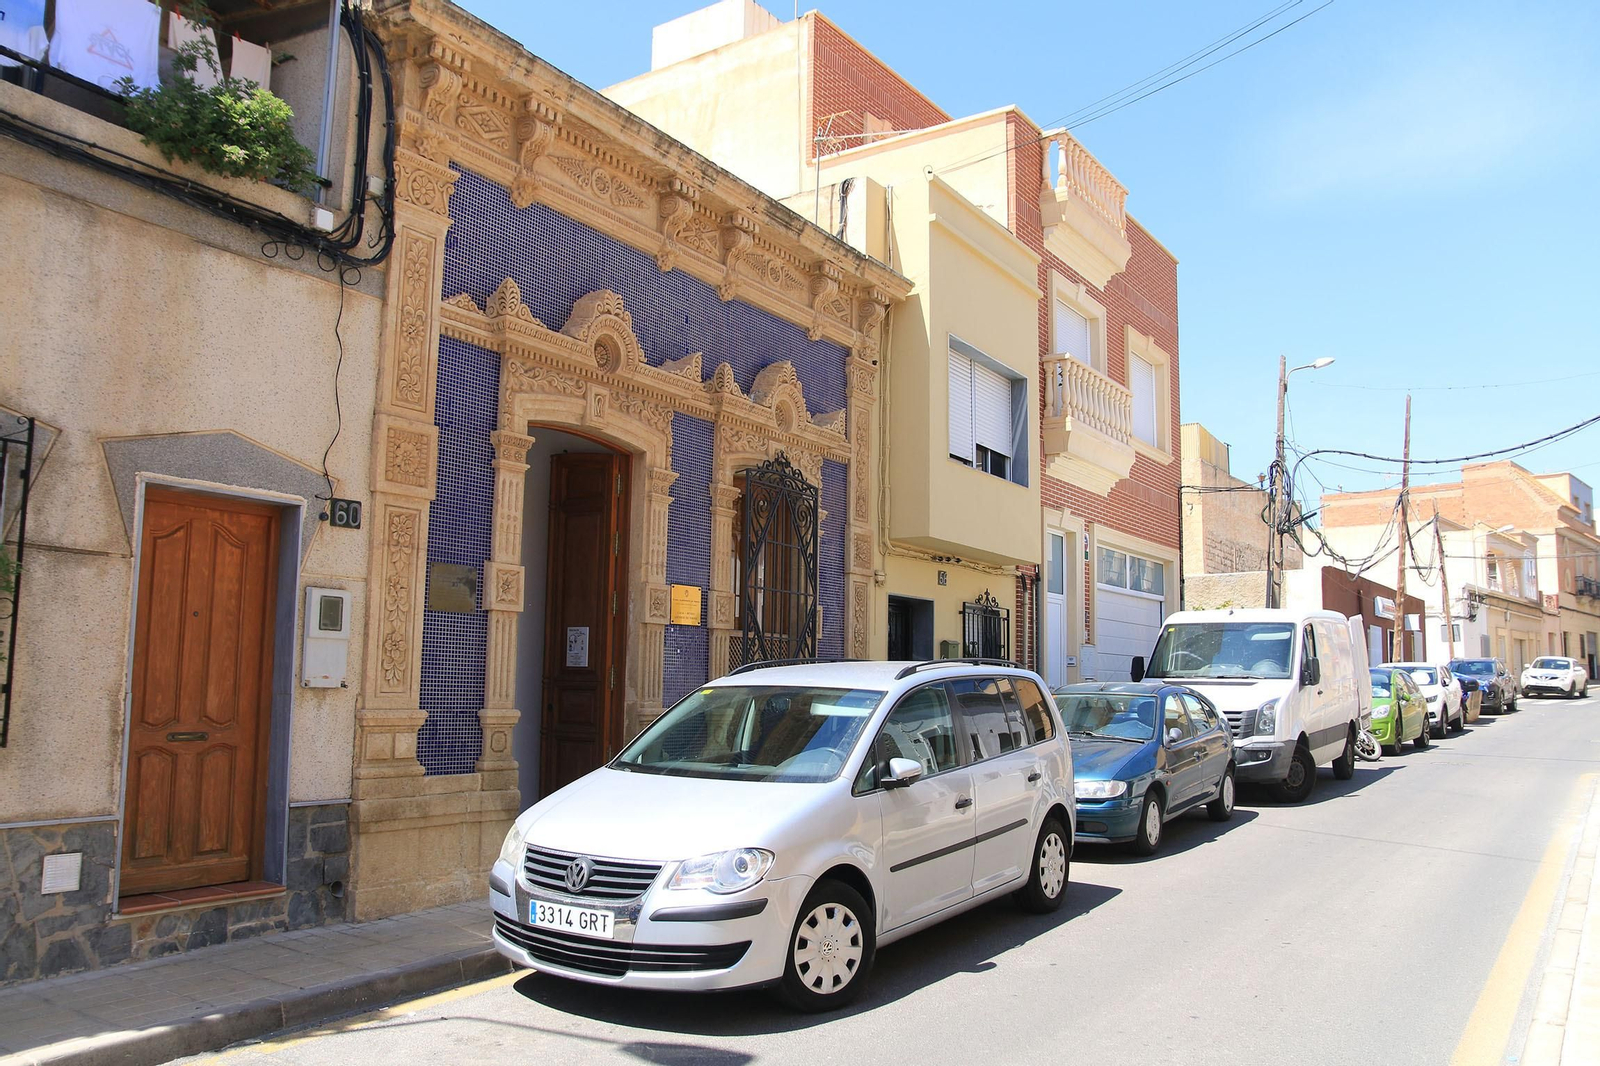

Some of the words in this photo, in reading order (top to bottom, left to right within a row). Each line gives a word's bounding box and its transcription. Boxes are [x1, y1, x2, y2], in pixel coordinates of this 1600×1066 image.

[334, 500, 361, 527] 60
[538, 904, 574, 927] 3314
[579, 911, 609, 933] GRT
